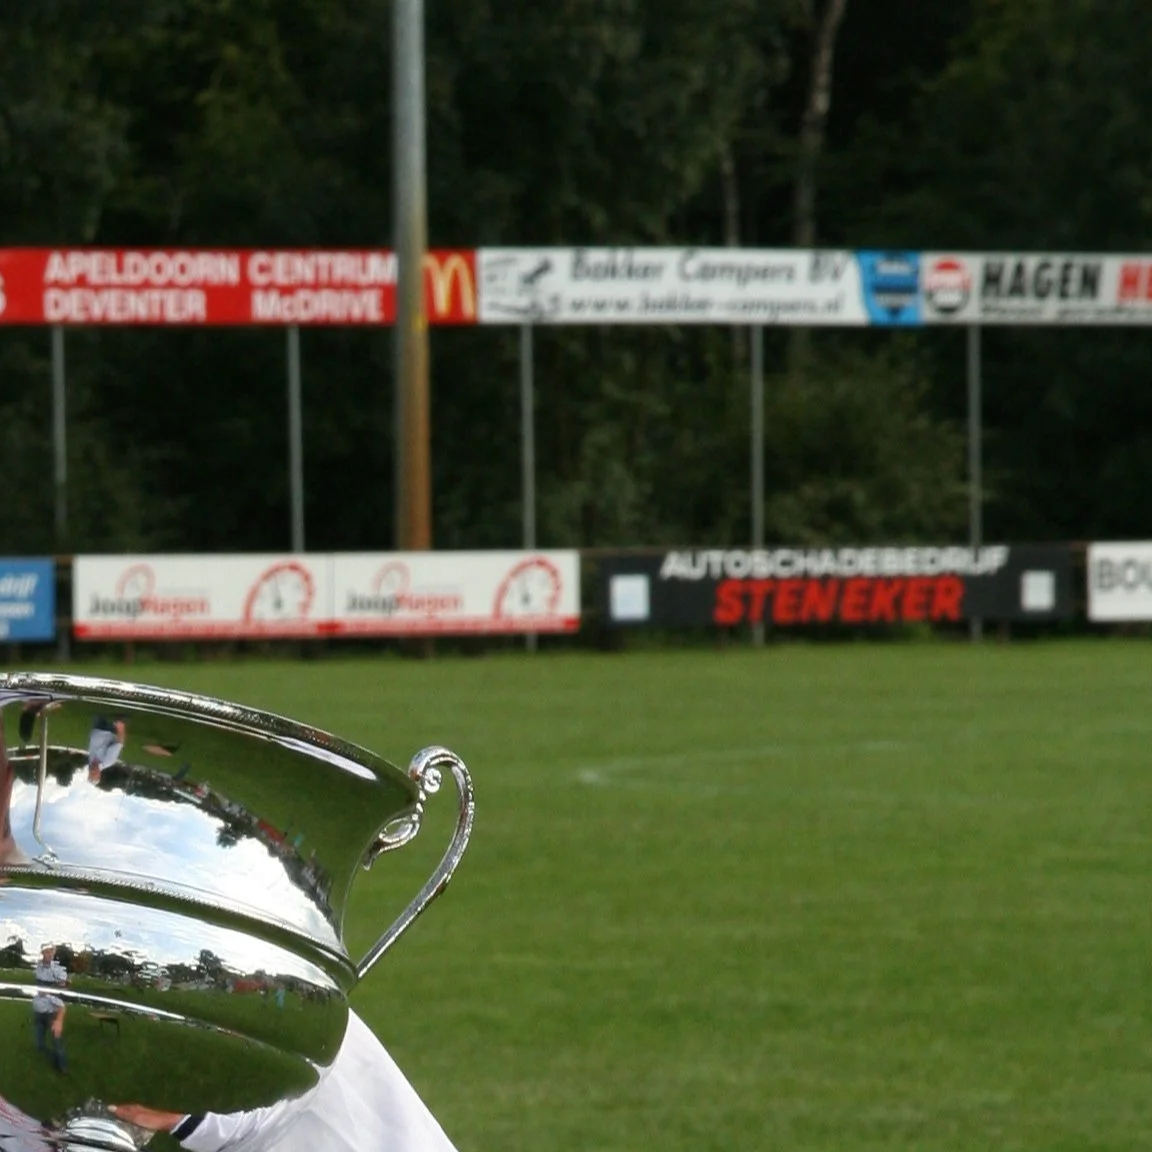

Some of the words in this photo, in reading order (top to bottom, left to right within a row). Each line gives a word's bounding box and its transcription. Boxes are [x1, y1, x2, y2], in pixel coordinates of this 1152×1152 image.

[45, 252, 240, 285] APELDOORN
[247, 253, 397, 285] CENTRUM
[981, 257, 1103, 299] HAGEN
[43, 288, 206, 320] DEVENTER
[251, 289, 384, 320] McDRIVE
[659, 545, 1011, 581] AUTOSCHADEBEDRIJF
[713, 575, 966, 626] STENEKER
